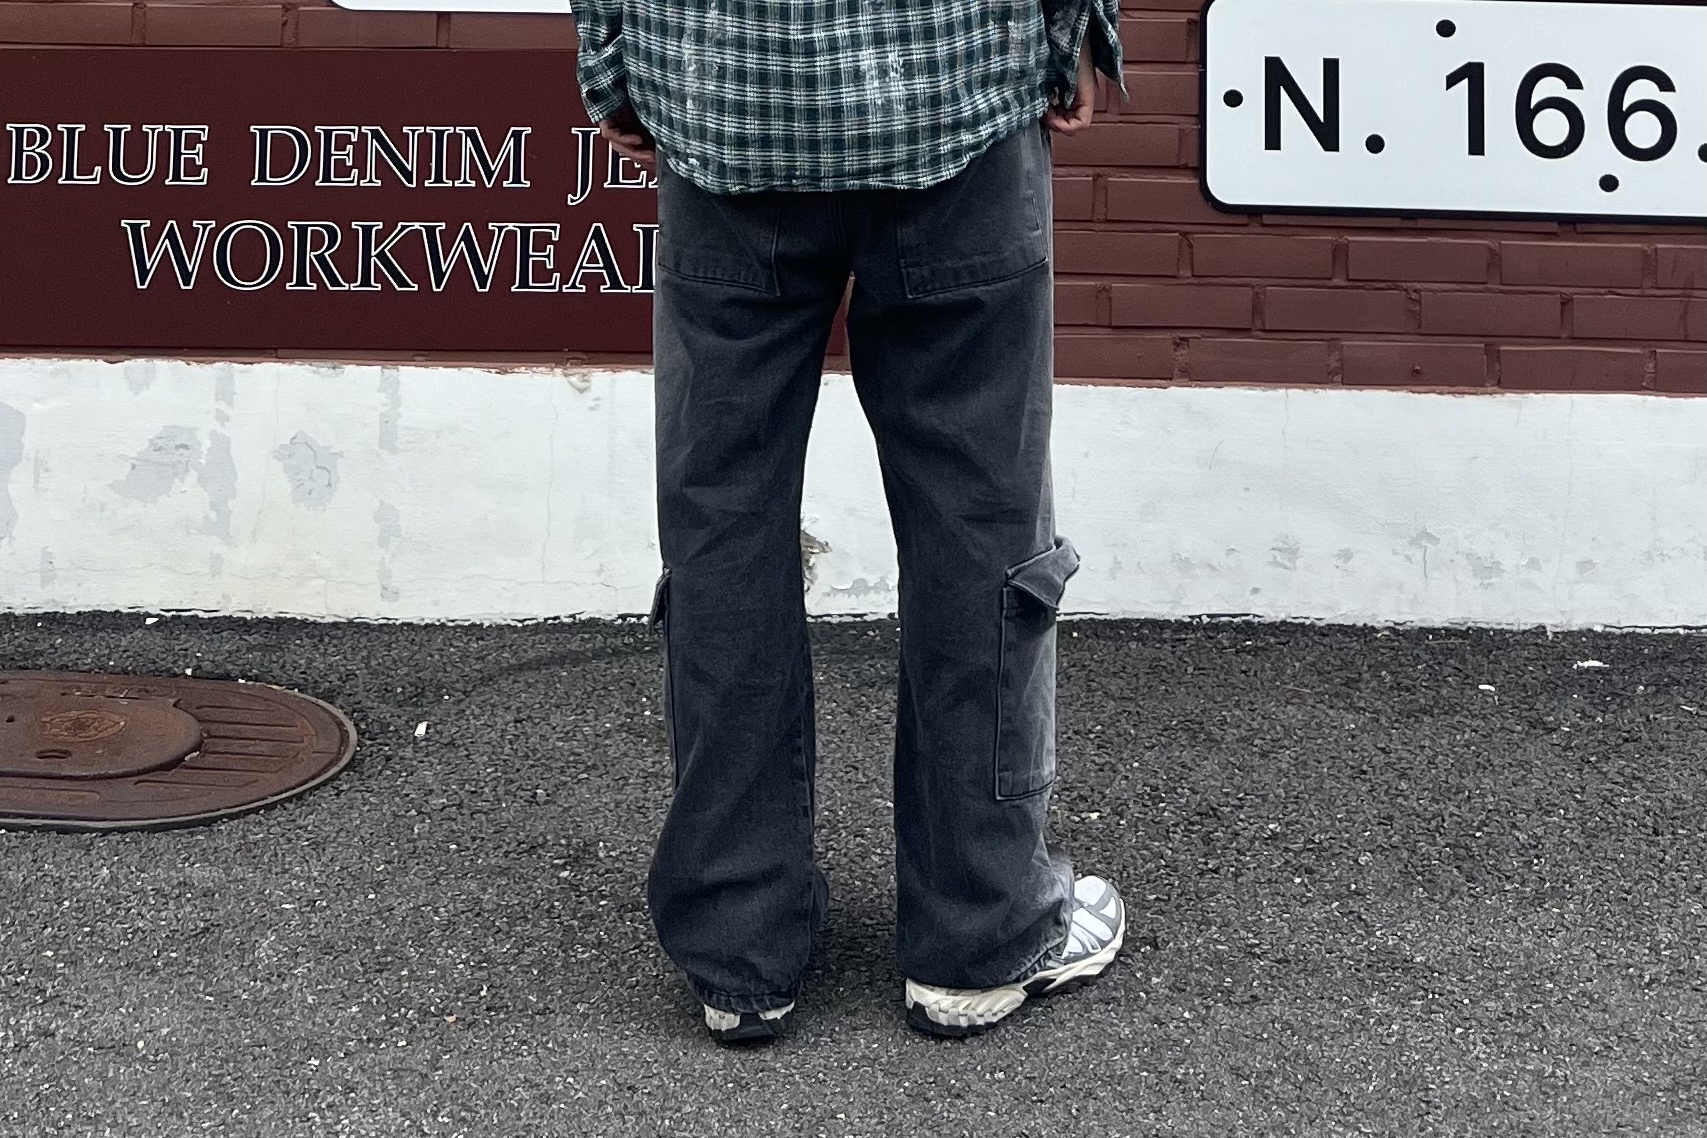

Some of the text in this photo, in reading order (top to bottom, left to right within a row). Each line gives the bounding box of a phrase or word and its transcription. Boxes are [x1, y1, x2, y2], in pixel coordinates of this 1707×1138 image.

[6, 122, 658, 206] BLUE DENIM JE
